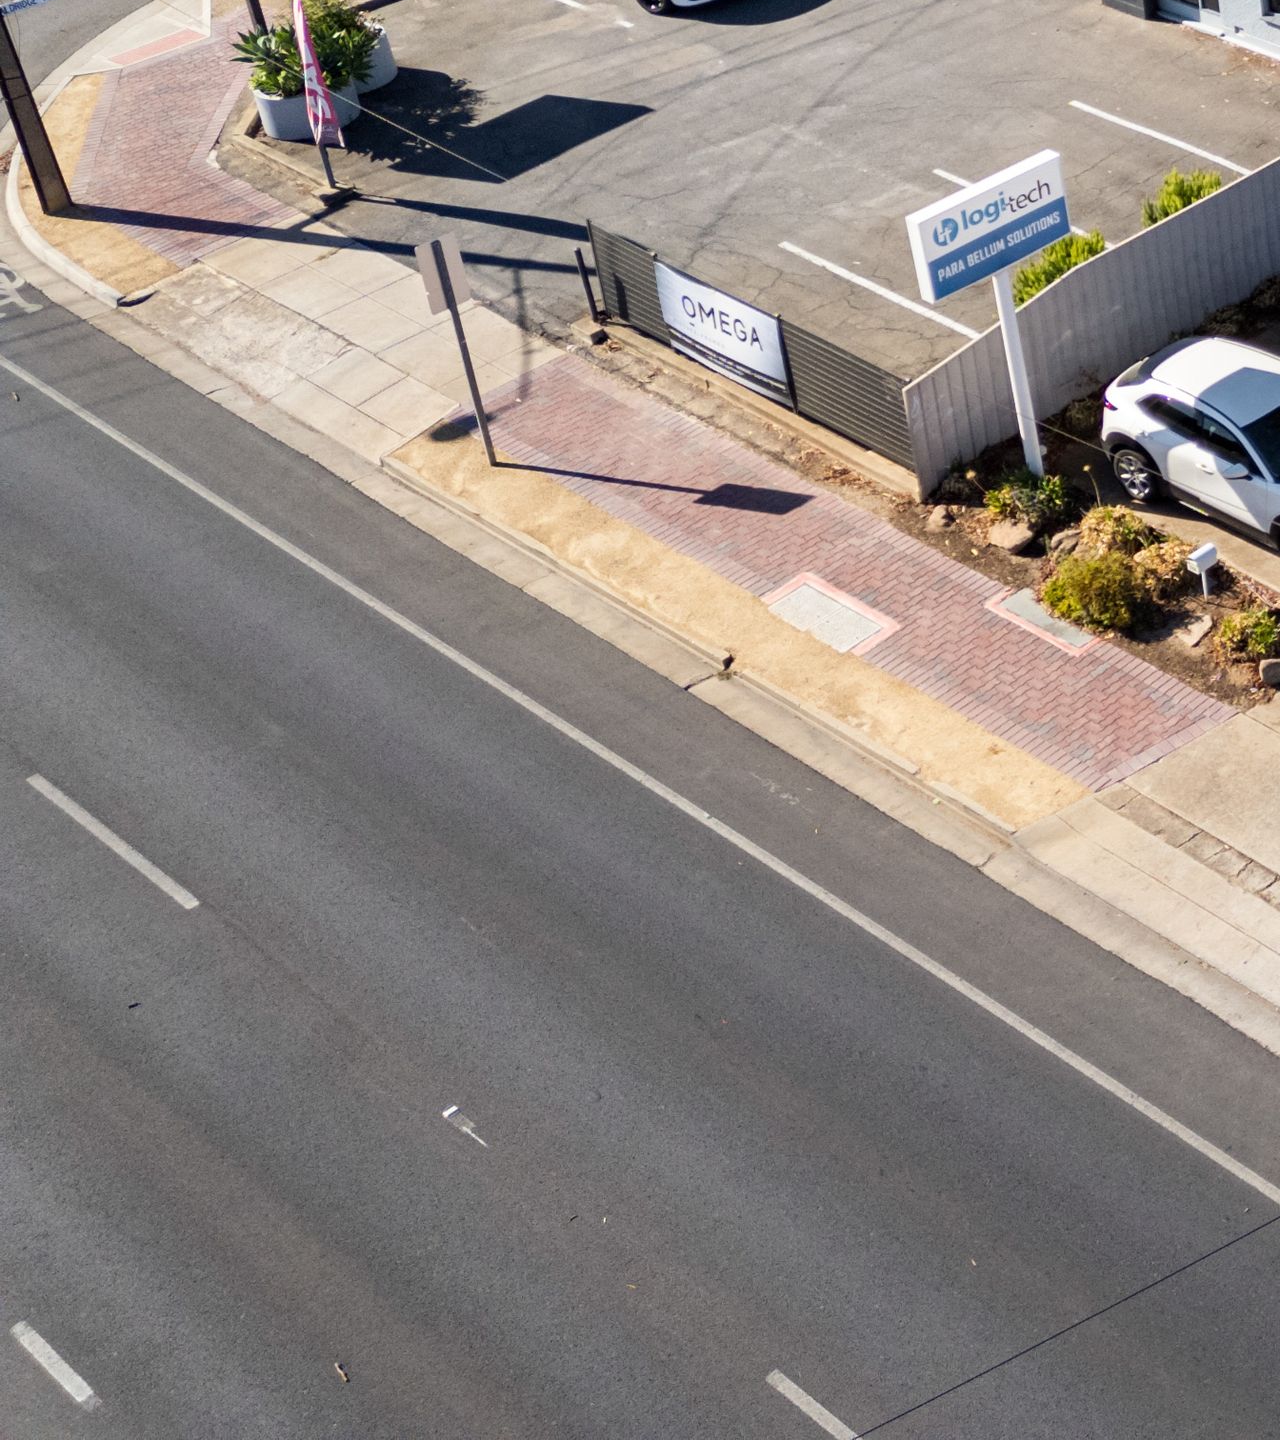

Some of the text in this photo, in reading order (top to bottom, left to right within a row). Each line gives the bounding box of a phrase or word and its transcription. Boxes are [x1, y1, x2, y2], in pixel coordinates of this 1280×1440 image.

[937, 211, 1061, 282] PARA BELLUM SOLUTIONS
[682, 295, 764, 352] OMEGA
